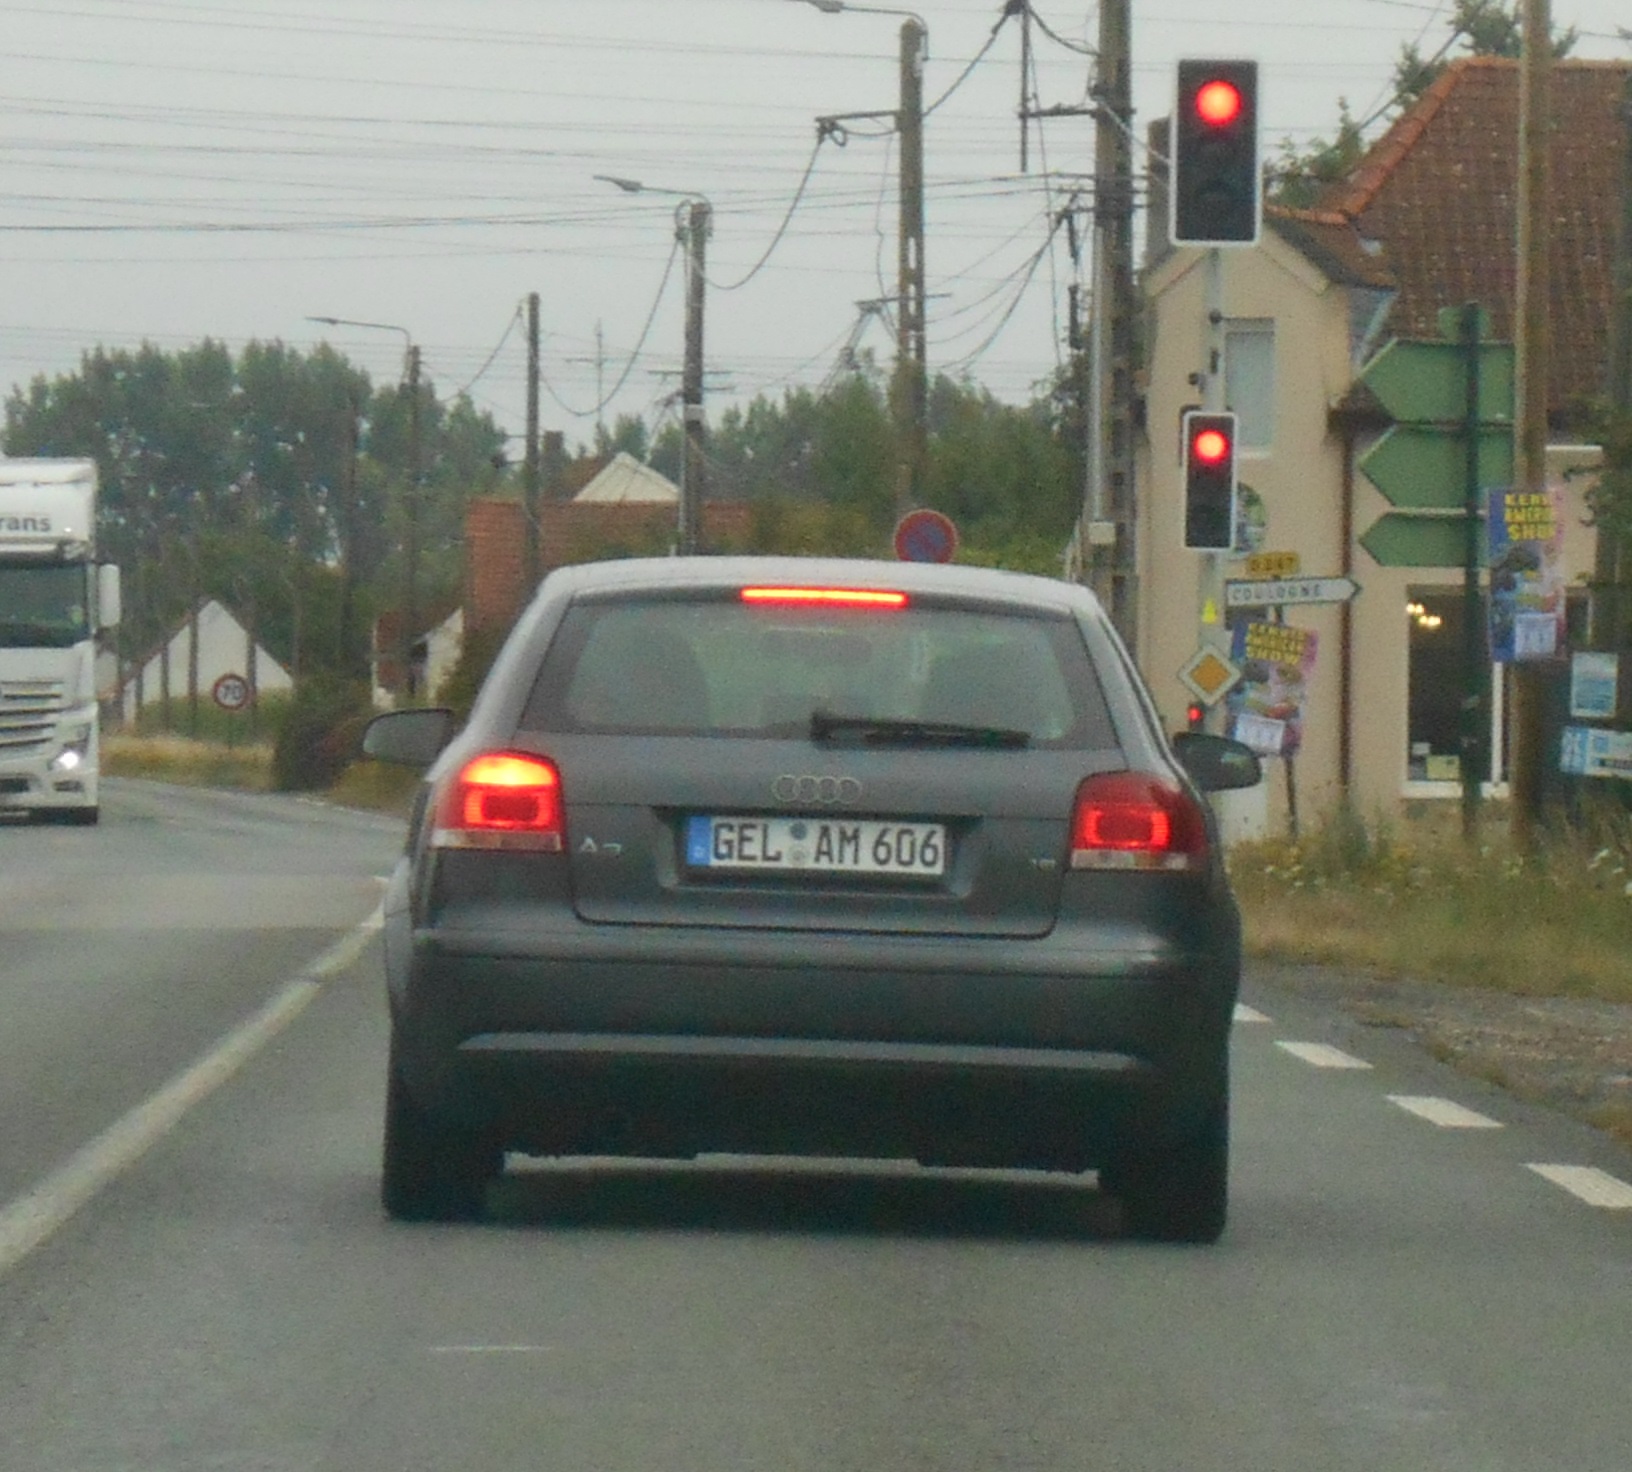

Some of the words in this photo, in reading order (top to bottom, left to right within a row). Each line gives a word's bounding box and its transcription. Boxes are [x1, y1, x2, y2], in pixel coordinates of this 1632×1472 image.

[713, 822, 782, 861] GEL
[814, 825, 860, 864] AM
[873, 828, 939, 867] 606
